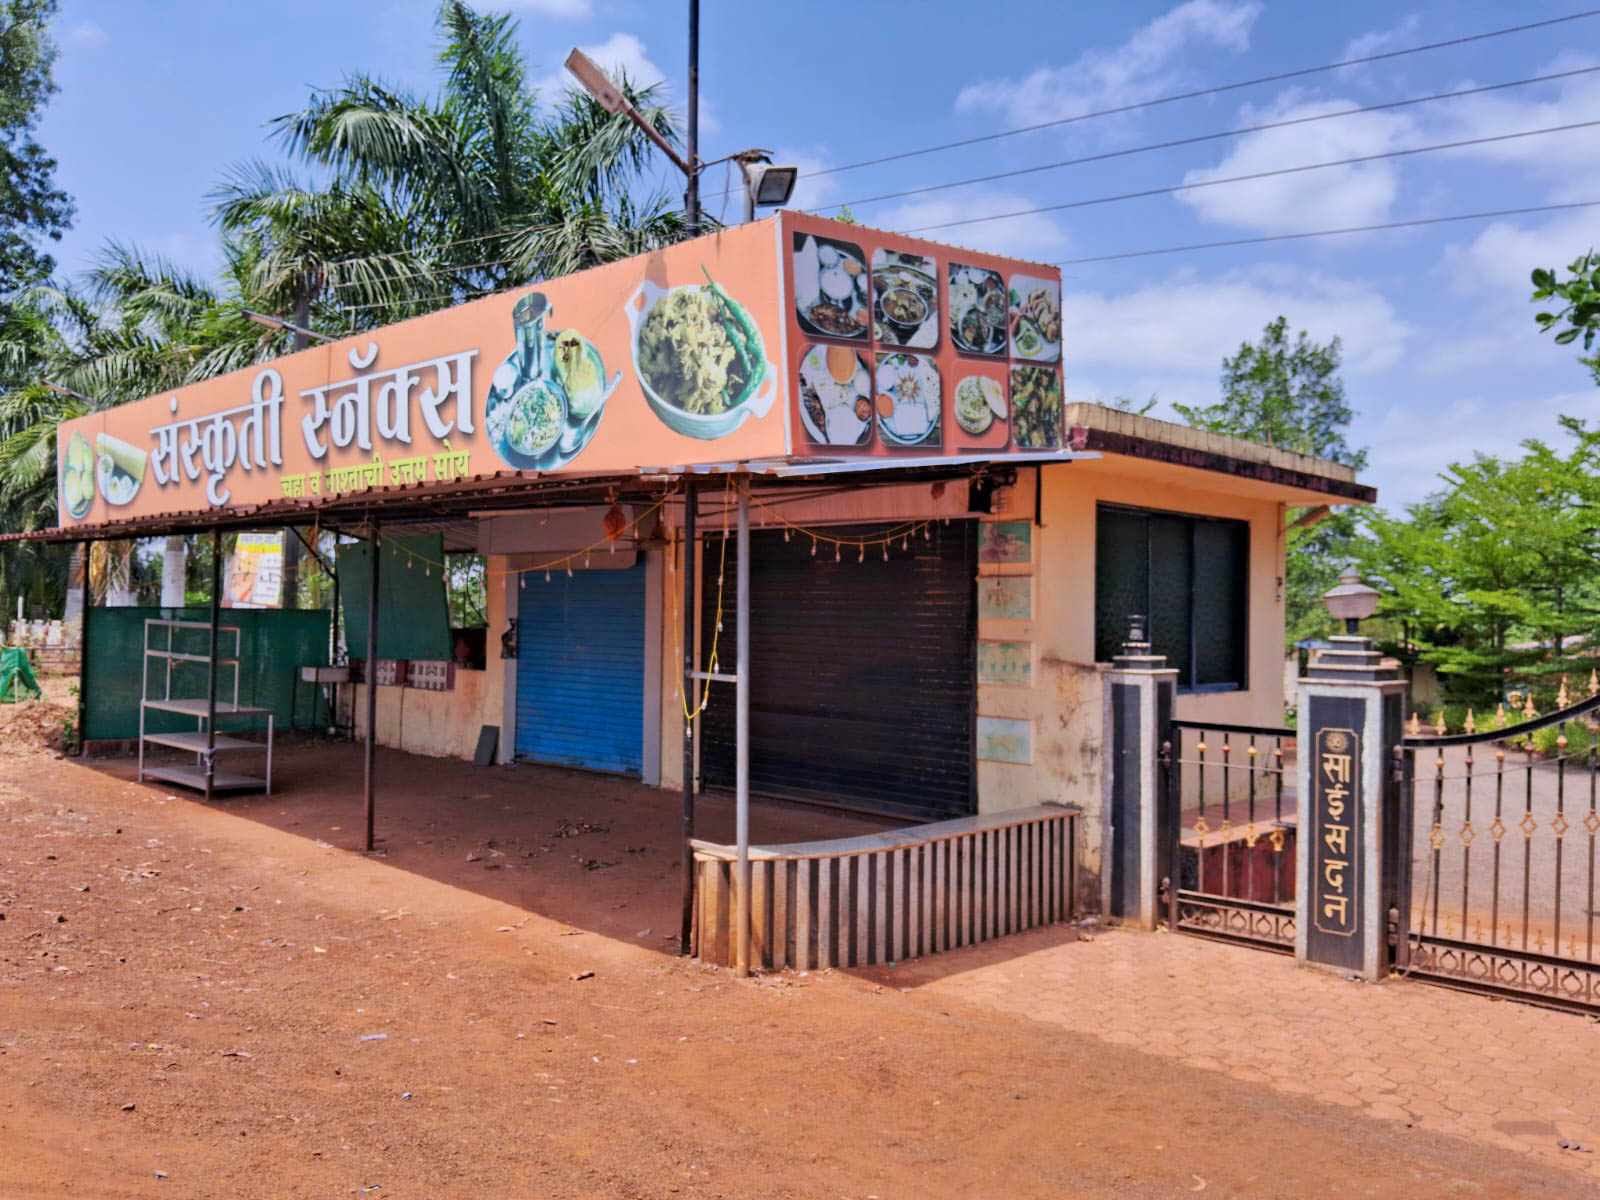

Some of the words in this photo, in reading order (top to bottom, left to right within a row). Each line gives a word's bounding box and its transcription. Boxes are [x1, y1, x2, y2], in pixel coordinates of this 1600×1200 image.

[149, 367, 284, 506] संस्कृती
[299, 341, 480, 458] स्नॅक्स
[280, 474, 306, 499] चहा
[309, 472, 321, 496] व
[388, 455, 428, 487] उत्तम
[432, 438, 471, 480] सोय
